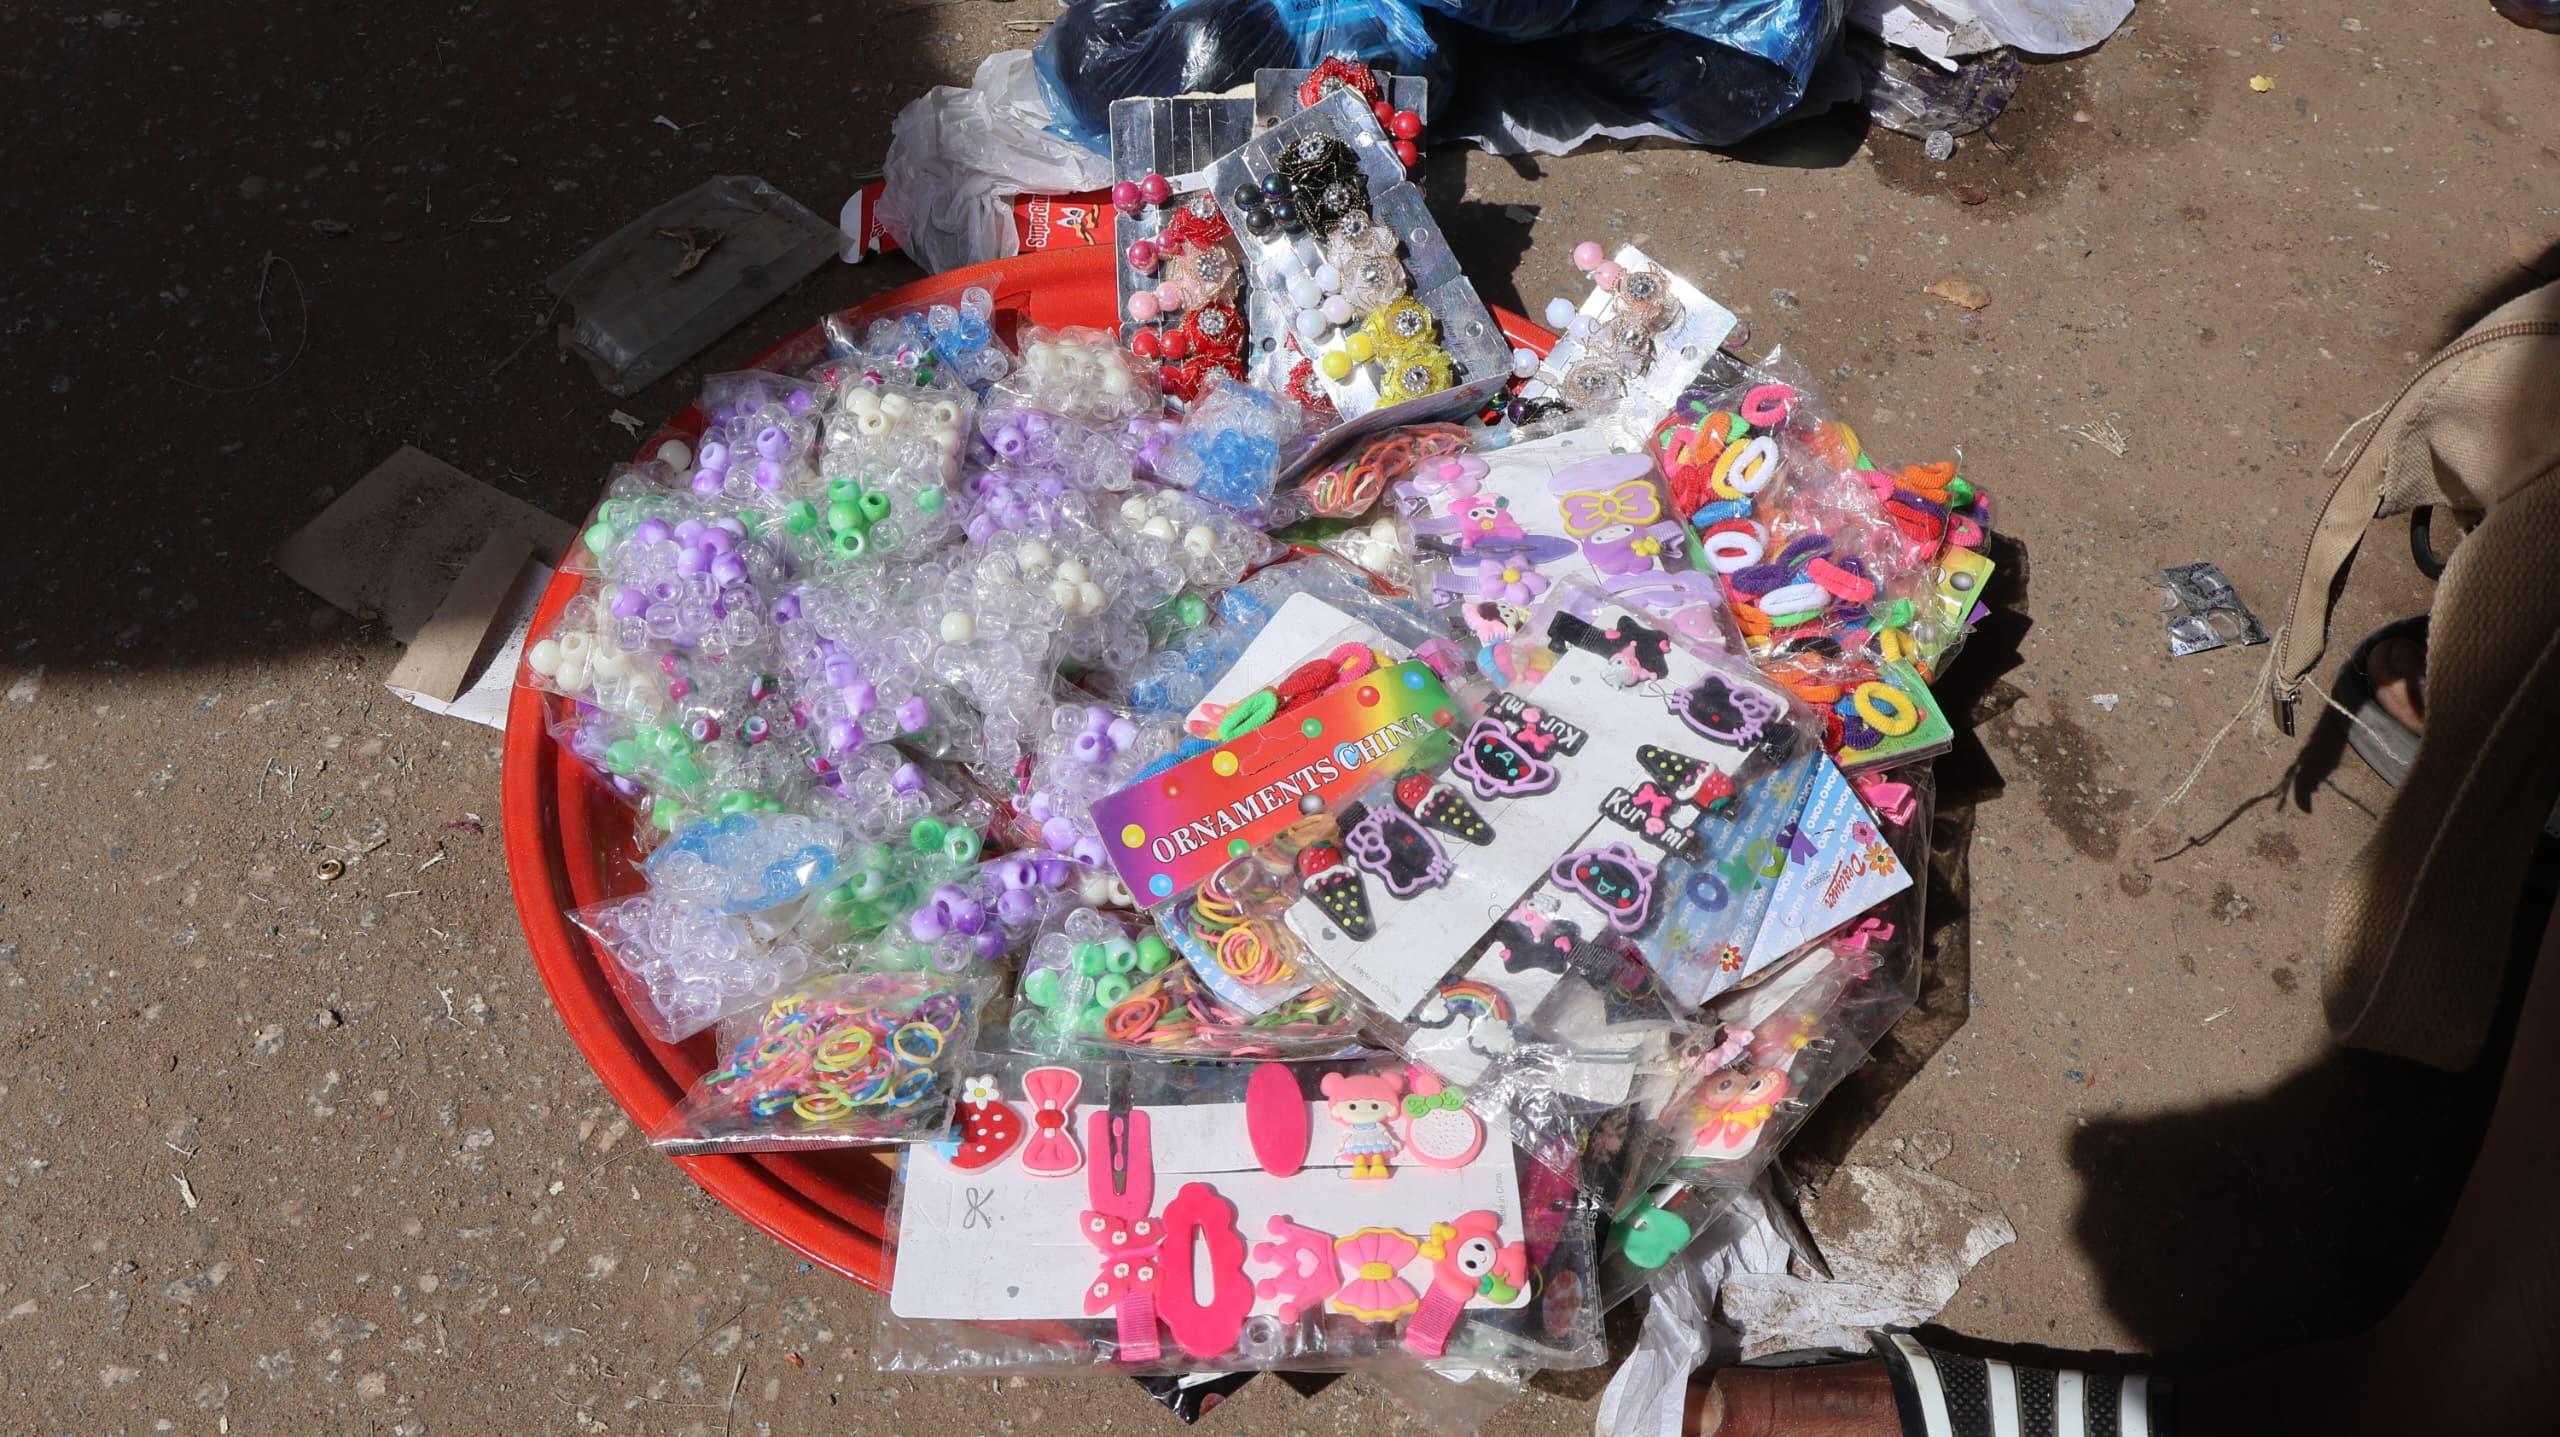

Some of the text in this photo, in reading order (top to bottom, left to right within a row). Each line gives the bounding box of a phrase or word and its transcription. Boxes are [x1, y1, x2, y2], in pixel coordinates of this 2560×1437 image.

[1151, 712, 1436, 863] ORNAMENTS CHINA
[1806, 799, 1824, 828] KOKO
[1824, 854, 1866, 909] Designer
